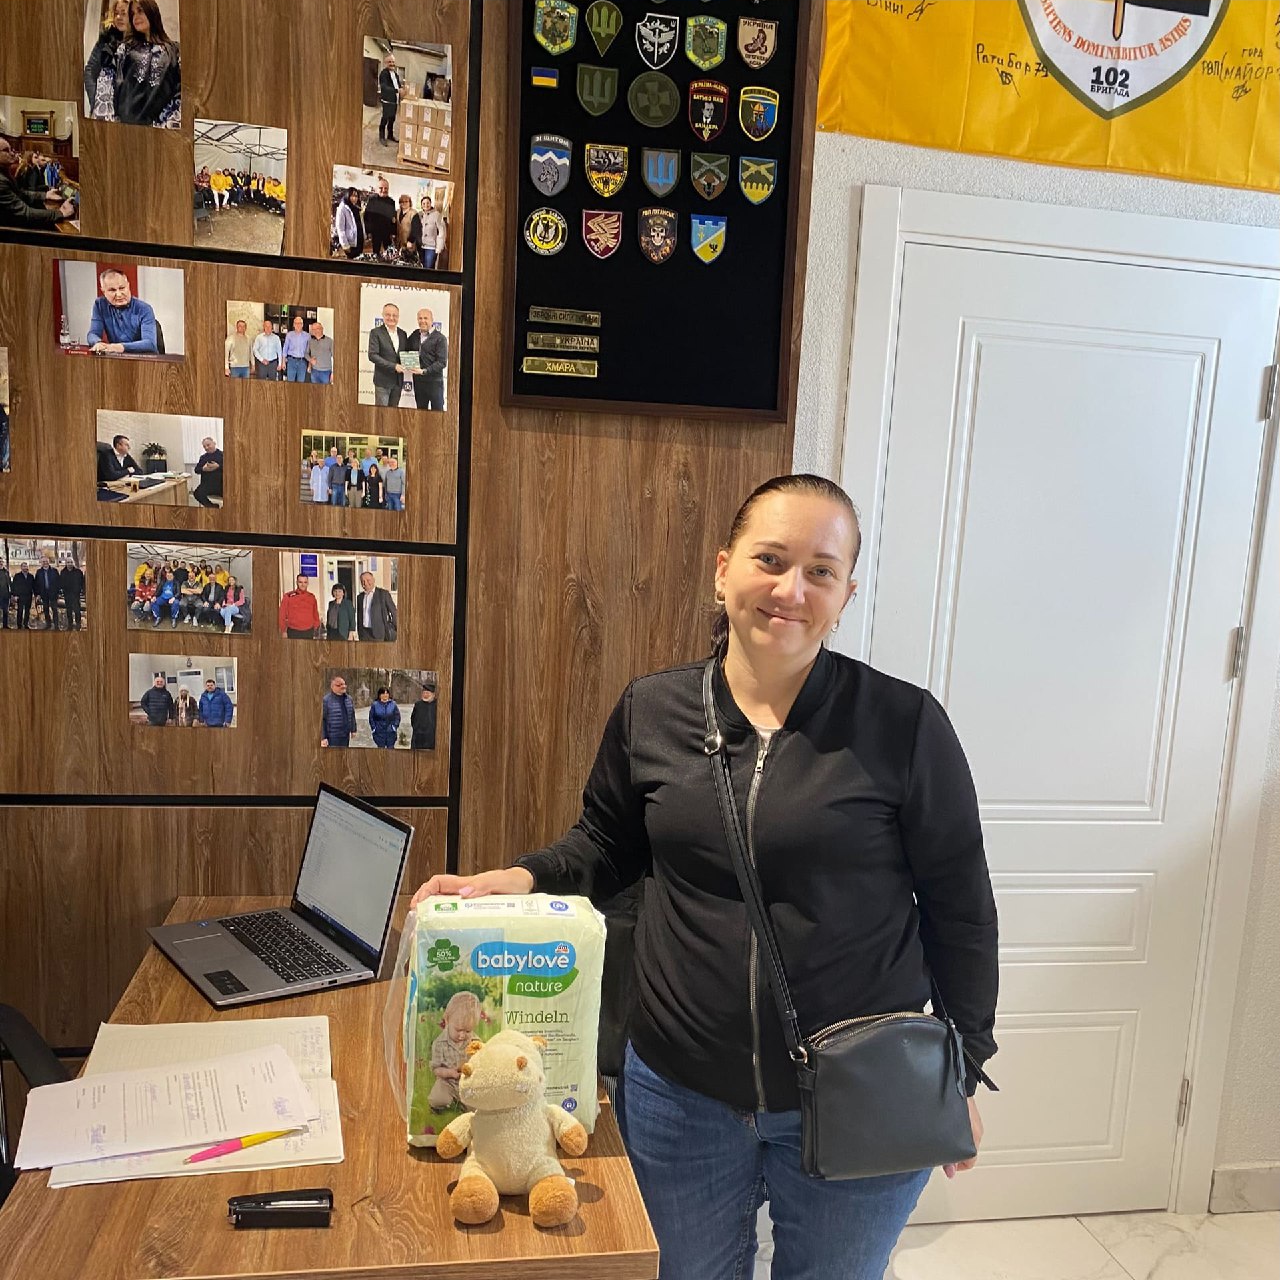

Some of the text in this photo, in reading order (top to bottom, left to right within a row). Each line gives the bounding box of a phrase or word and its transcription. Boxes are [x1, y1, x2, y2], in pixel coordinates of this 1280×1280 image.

[866, 0, 903, 14] інні
[1040, 0, 1073, 43] APIENS
[1090, 65, 1130, 89] 102
[1090, 85, 1130, 98] БРИГАДА
[545, 362, 576, 373] ХМАРА
[477, 950, 570, 973] babylove
[515, 981, 564, 992] nature
[504, 1010, 570, 1024] Windeln
